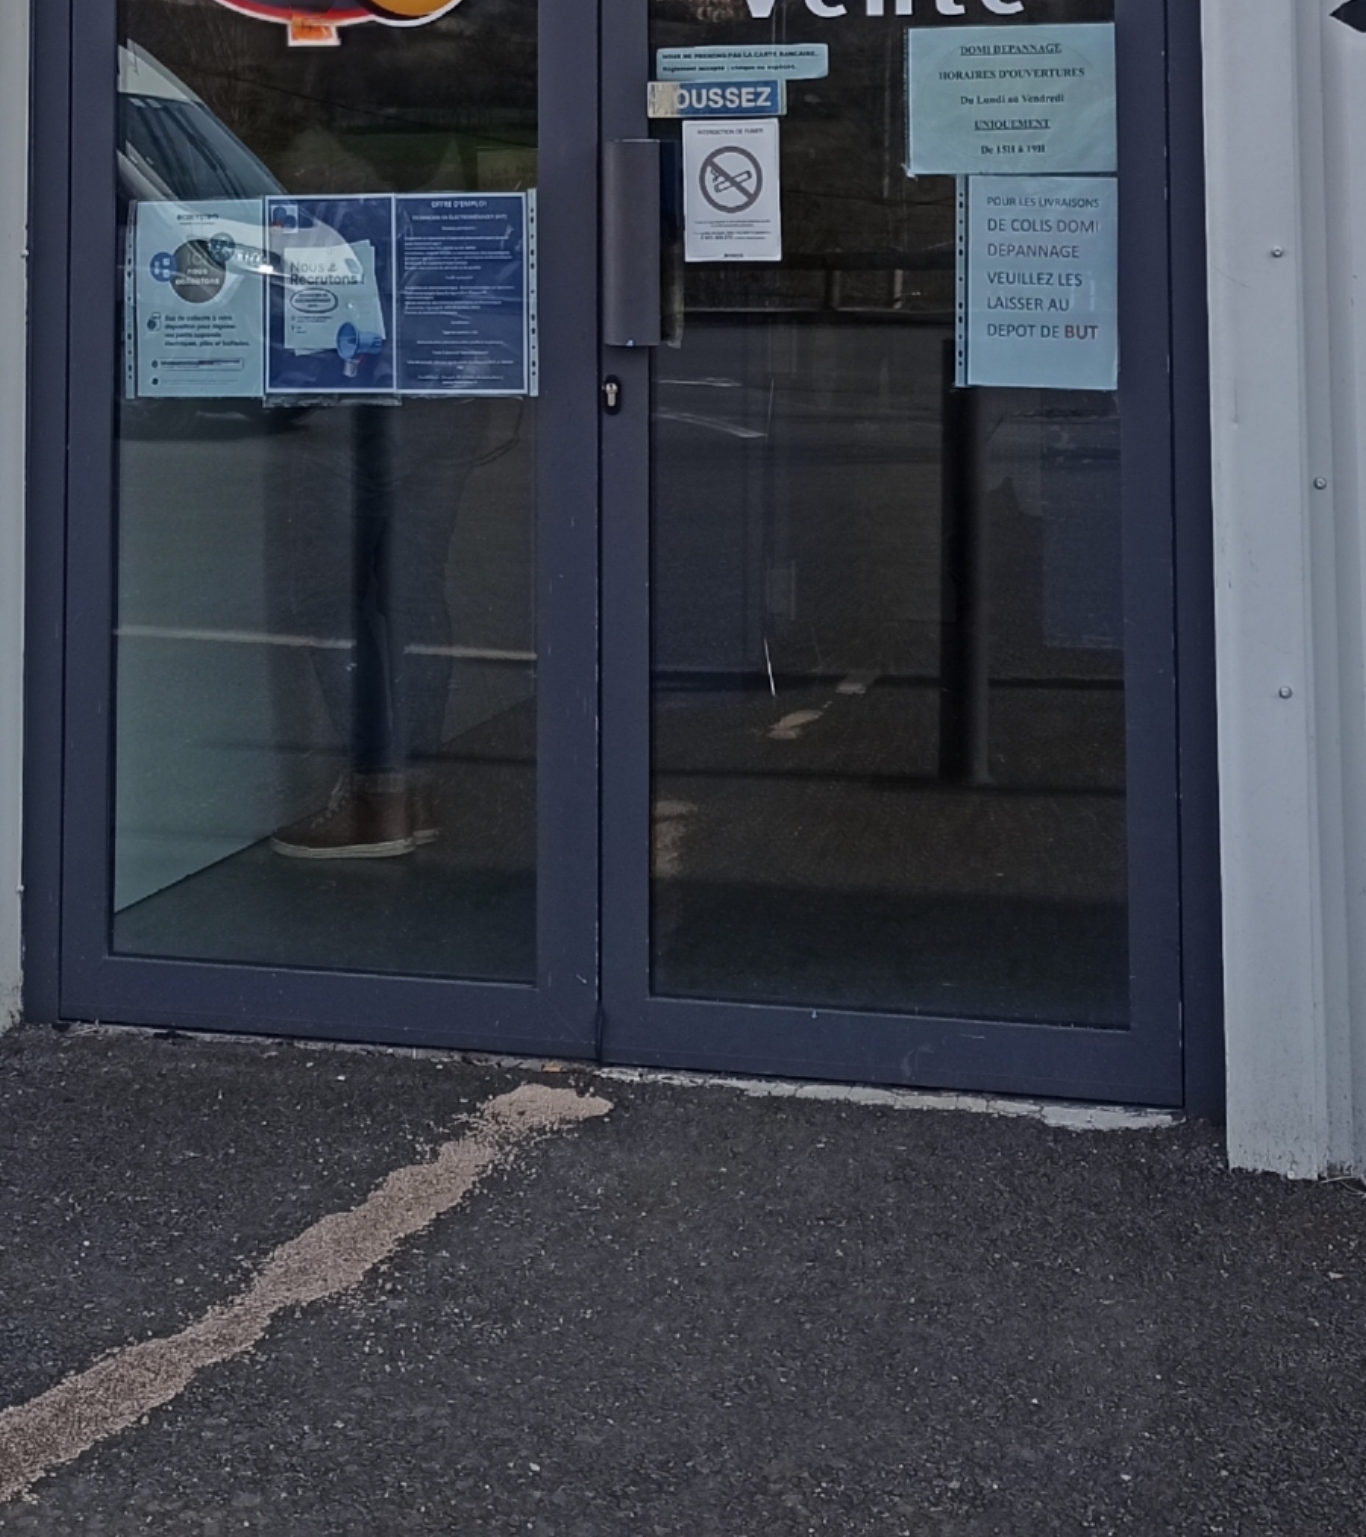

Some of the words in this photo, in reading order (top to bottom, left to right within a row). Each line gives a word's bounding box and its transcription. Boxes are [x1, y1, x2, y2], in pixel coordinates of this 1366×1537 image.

[960, 45, 991, 56] DOMI
[993, 43, 1063, 55] DEPANNAGE
[939, 69, 996, 80] HORAIRES
[998, 67, 1086, 79] D'OUVERTURES
[676, 86, 772, 109] OUSSEZ
[960, 96, 974, 105] Du
[977, 95, 1006, 104] Lundi
[1008, 96, 1019, 104] au
[1022, 93, 1065, 104] Vendredi
[974, 119, 1051, 131] UNIQUEMENT
[981, 145, 994, 155] De
[987, 196, 1016, 207] POUR
[1019, 197, 1036, 207] LES
[1039, 197, 1100, 208] LIVRAISONS
[987, 219, 1006, 232] DE
[1010, 219, 1053, 233] COLIS
[1057, 220, 1099, 234] DOMI
[987, 243, 1080, 258] DEPANNAGE
[290, 262, 325, 273] Nous
[290, 274, 358, 285] Recrutons
[987, 271, 1054, 285] VEUILLEZ
[1058, 273, 1083, 287] LES
[987, 296, 1044, 311] LAISSER
[1047, 298, 1070, 311] AU
[987, 324, 1036, 337] DEPOT
[1040, 325, 1060, 338] DE
[1064, 325, 1099, 340] BUT
